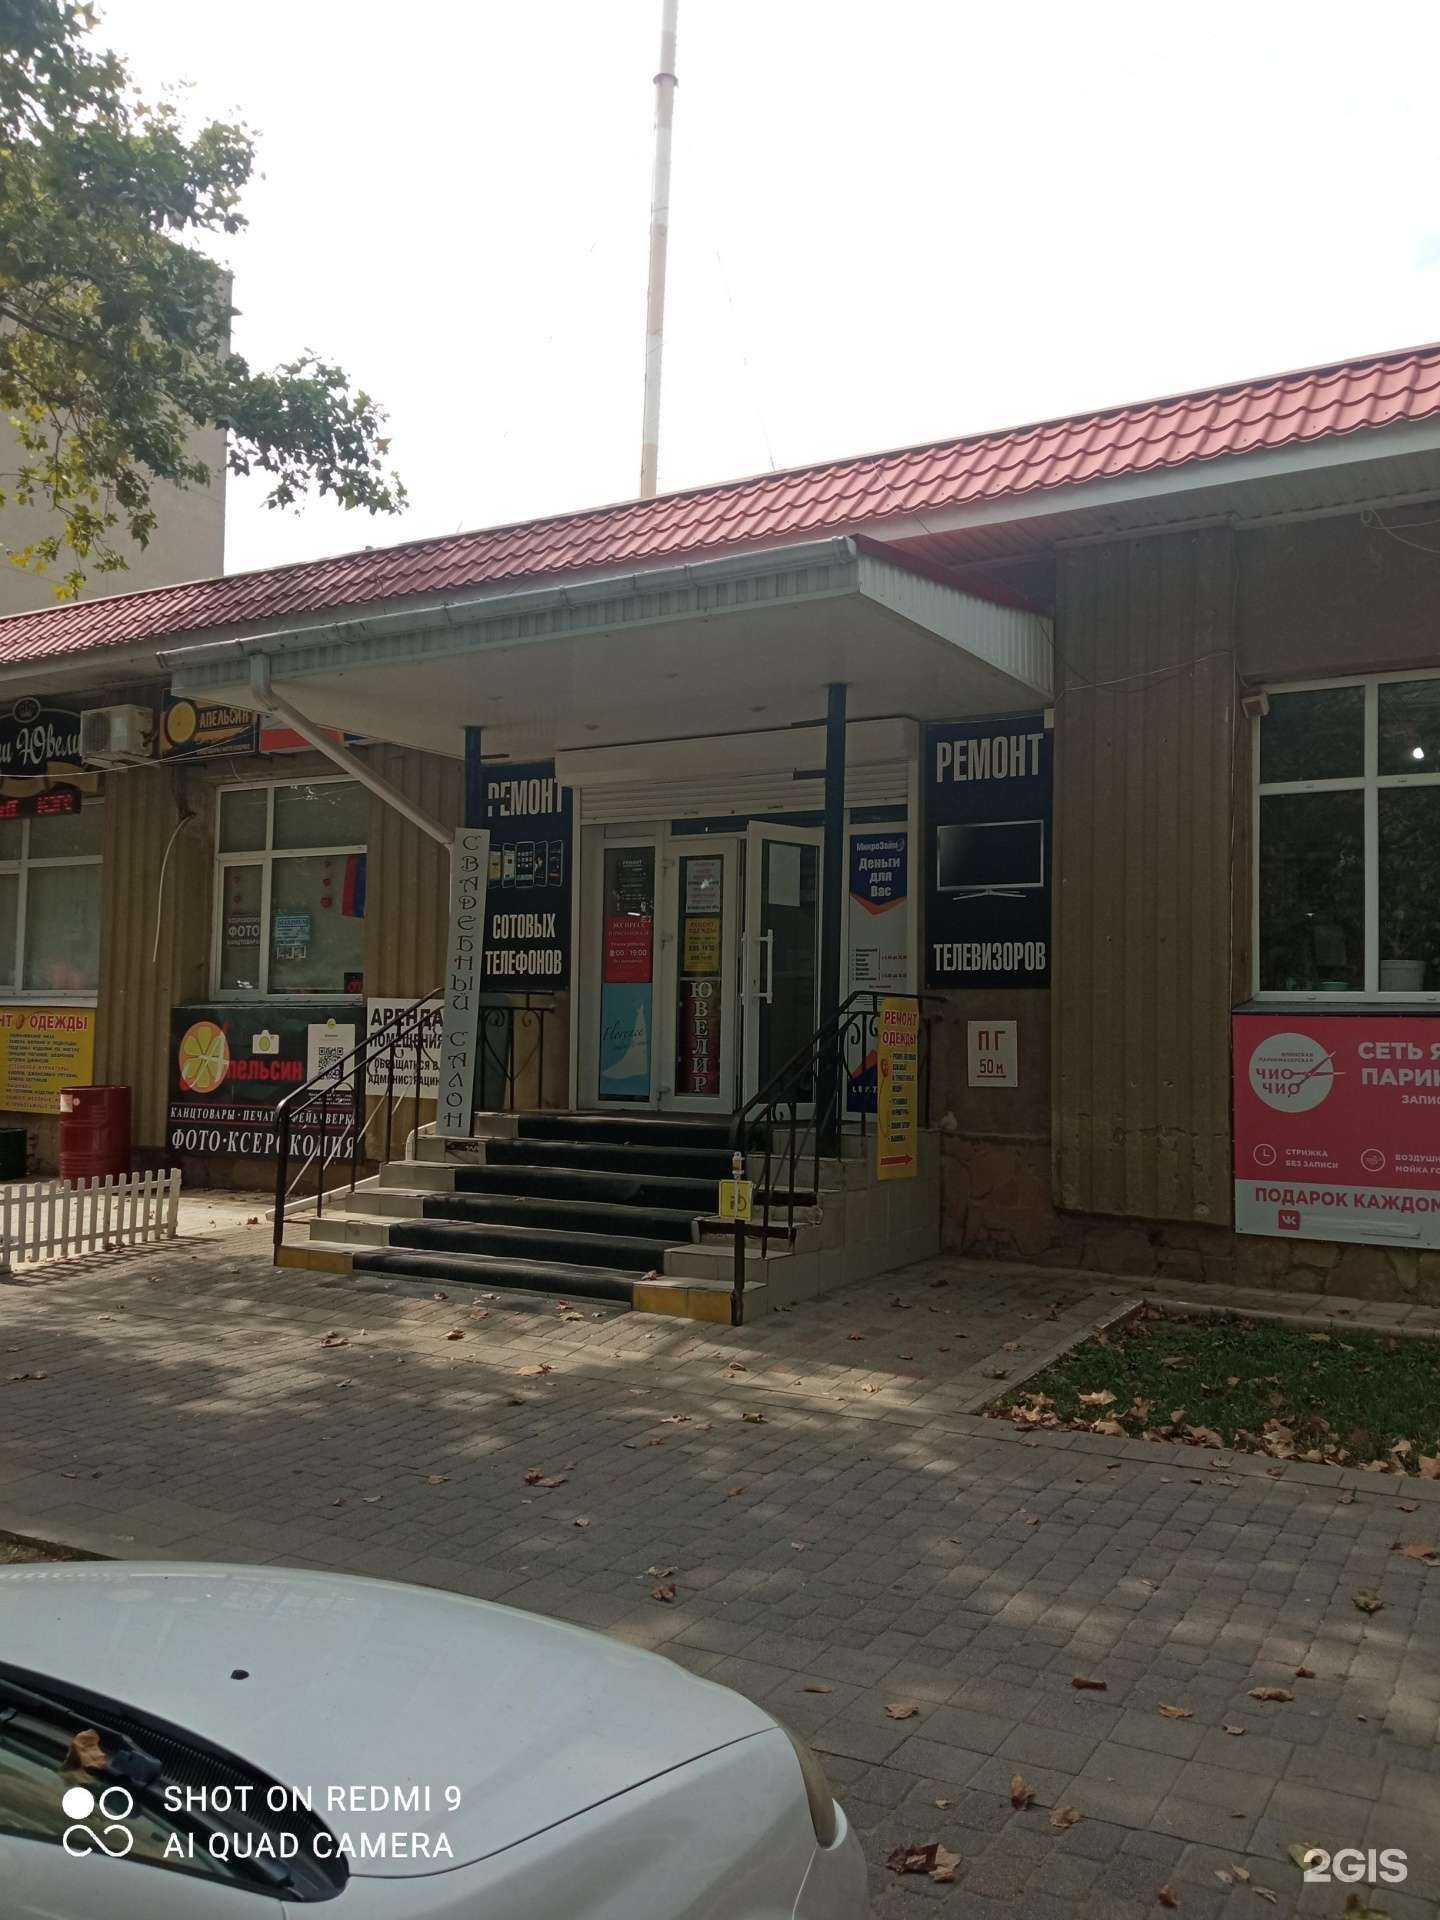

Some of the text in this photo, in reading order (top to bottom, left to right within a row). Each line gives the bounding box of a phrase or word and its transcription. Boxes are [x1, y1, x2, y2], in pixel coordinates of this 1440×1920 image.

[200, 710, 249, 729] АПЕЛЬСИН
[936, 733, 1044, 783] РЕМОНТ
[487, 777, 562, 818] РЕМОНТ
[859, 857, 901, 872] Деньги
[870, 885, 893, 897] Вас
[228, 925, 260, 937] ФОТО
[492, 913, 556, 940] СОТОВЫХ
[485, 949, 562, 976] ТЕЛЕФОНОВ
[933, 942, 1046, 972] ТЕЛЕВИЗОРОВ
[443, 835, 482, 1129] СВАДЕБНЫЙ САЛОН
[30, 1014, 88, 1031] ОДЕЖДЫ
[884, 1010, 917, 1026] РЕМОНТ
[690, 981, 713, 1093] ЮВЕЛИР
[882, 1031, 916, 1047] ОДЕЖДЫ
[1358, 1041, 1424, 1060] СЕТЬ
[980, 1059, 994, 1074] 50
[1256, 1068, 1294, 1080] ЧИО
[1262, 1082, 1300, 1096] ЧИО
[170, 1106, 235, 1120] КАНЦТОВАРЫ
[171, 1128, 221, 1152] ФОТО
[1285, 1149, 1328, 1158] СТРИЖКА
[1285, 1160, 1338, 1169] БЕЗ ЗАПИСИ
[1395, 1165, 1428, 1174] МОЙКА
[1255, 1187, 1348, 1208] ПОДАРОК
